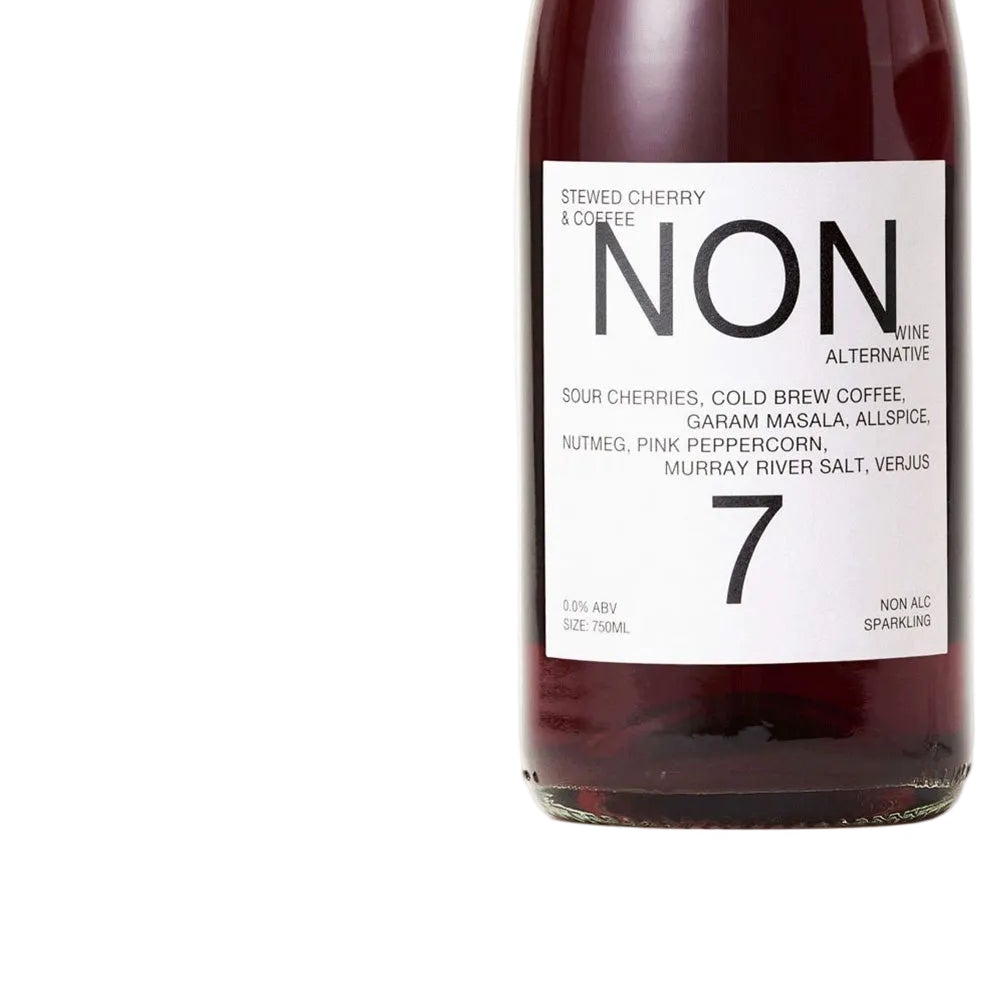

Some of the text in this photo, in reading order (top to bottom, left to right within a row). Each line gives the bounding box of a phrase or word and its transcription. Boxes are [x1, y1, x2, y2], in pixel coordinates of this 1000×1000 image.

[560, 188, 706, 205] STEWED CHERRY
[561, 211, 635, 226] & COFFEE
[595, 219, 896, 338] NON
[894, 324, 930, 340] WINE
[825, 345, 930, 364] ALTERNATIVE
[562, 386, 906, 408] SOUR CHERRIES, COLD BREW COFFEE,
[686, 408, 931, 430] GARAM MASALA, ALLSPICE,
[562, 434, 828, 455] NUTMEG, PINK PEPPERCORN,
[664, 454, 930, 476] MURRAY RIVER SALT, VERJUS
[712, 494, 783, 604] 7
[563, 599, 617, 615] 0.0% ABV
[880, 595, 932, 612] NON ALC
[563, 617, 630, 634] SIZE: 750ML
[863, 614, 932, 632] SPARKLING
